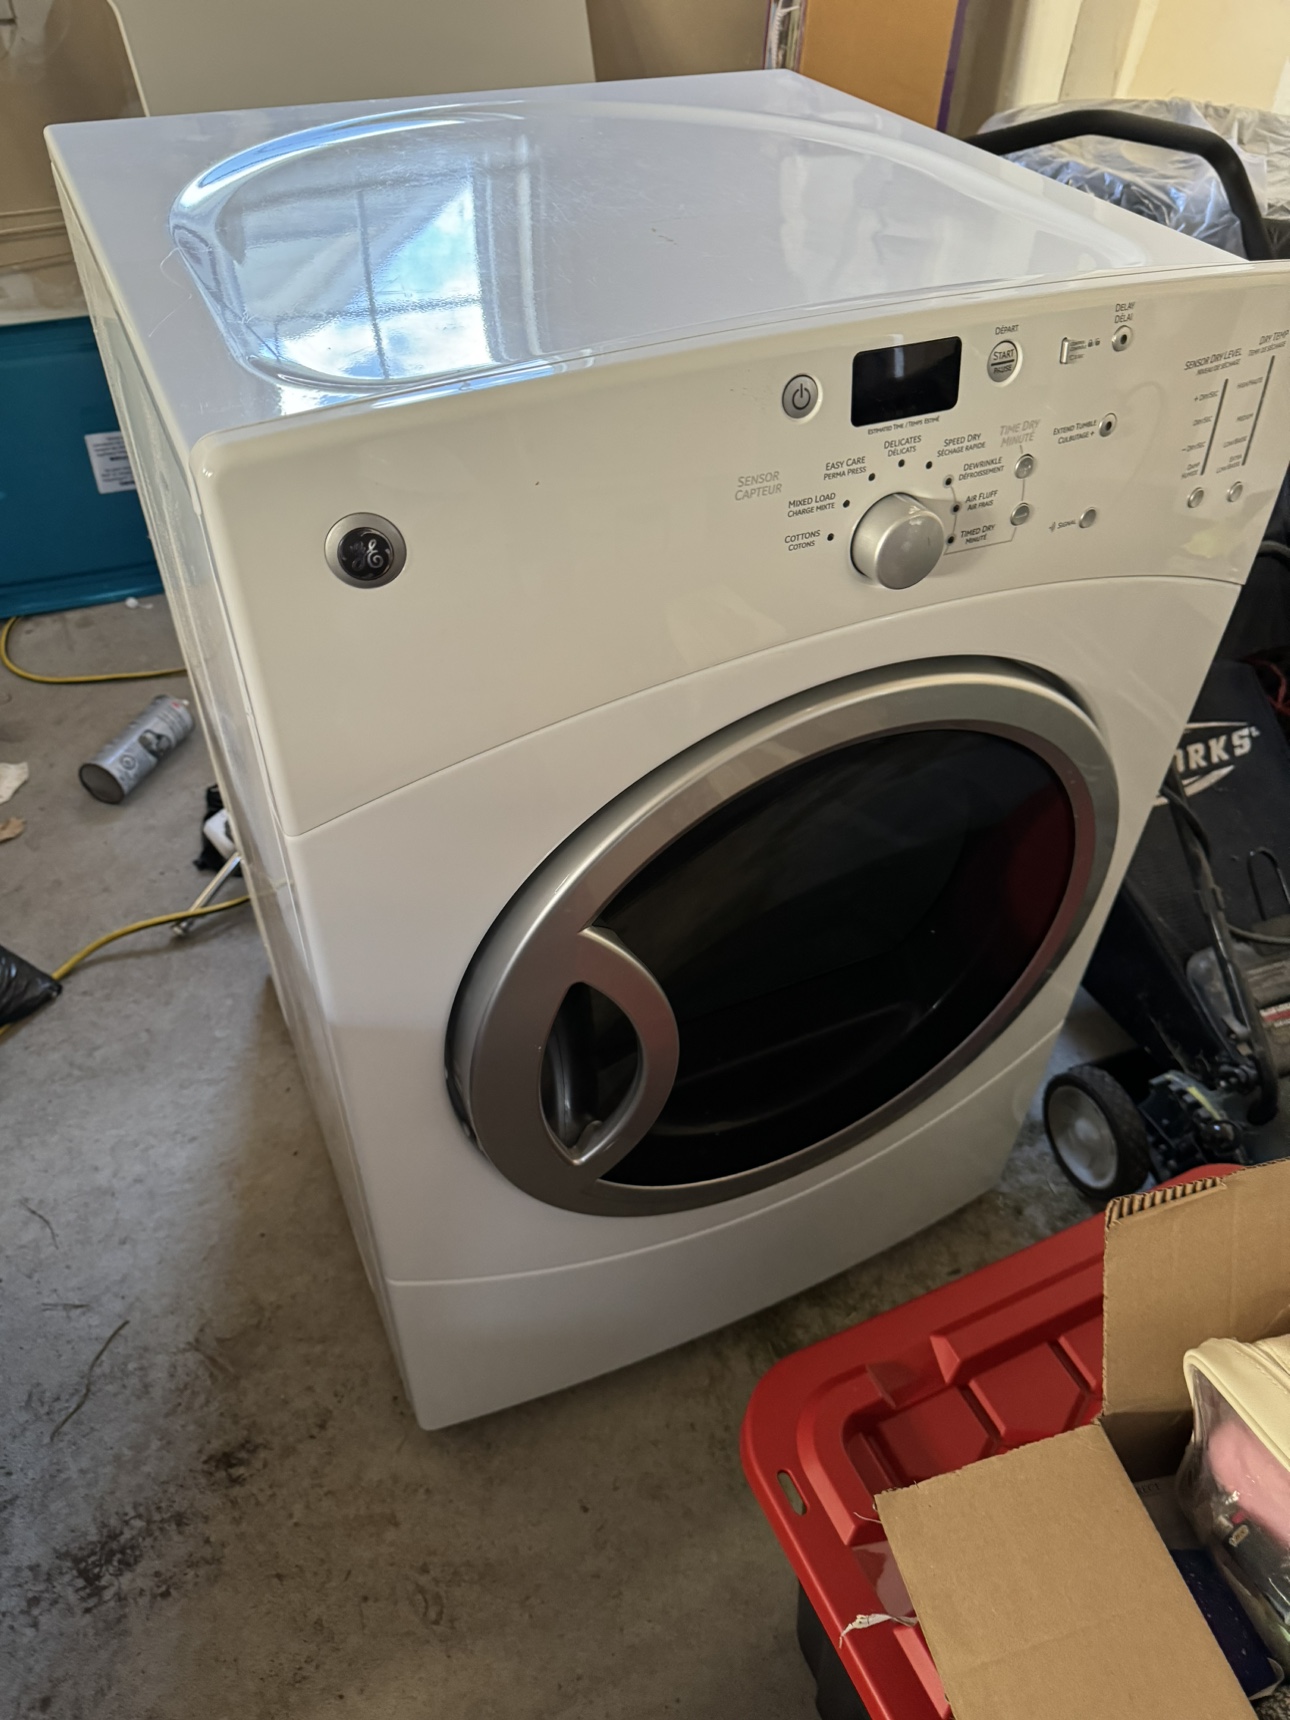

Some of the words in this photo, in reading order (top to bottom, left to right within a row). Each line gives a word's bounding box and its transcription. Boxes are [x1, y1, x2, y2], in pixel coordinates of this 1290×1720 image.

[1115, 301, 1136, 313] DELAY
[993, 348, 1015, 361] START
[993, 364, 1013, 374] PAUSE
[1000, 424, 1023, 437] TIME
[1023, 419, 1041, 432] DRY
[1053, 424, 1075, 436] EXTEND
[883, 434, 922, 450] DELICATES
[944, 436, 966, 448] SPEED
[967, 433, 982, 443] DRY
[964, 441, 987, 453] RAPIDE
[825, 460, 845, 472] EASY
[846, 456, 866, 467] CARE
[963, 456, 1003, 472] DEWRINKLE
[737, 470, 780, 488] SENSOR
[823, 470, 846, 481] PERMA
[847, 466, 867, 476] PRESS
[734, 483, 783, 501] CAPTEUR
[965, 494, 978, 503] AIR
[978, 489, 999, 500] FLUFF
[788, 498, 813, 509] MIXED
[815, 492, 836, 504] LOAD
[787, 506, 815, 518] CHARGE
[816, 502, 836, 513] MIXTE
[784, 530, 821, 544] COTTONS
[961, 527, 981, 538] TIMED
[982, 524, 996, 533] DRY
[788, 540, 816, 552] COTONS
